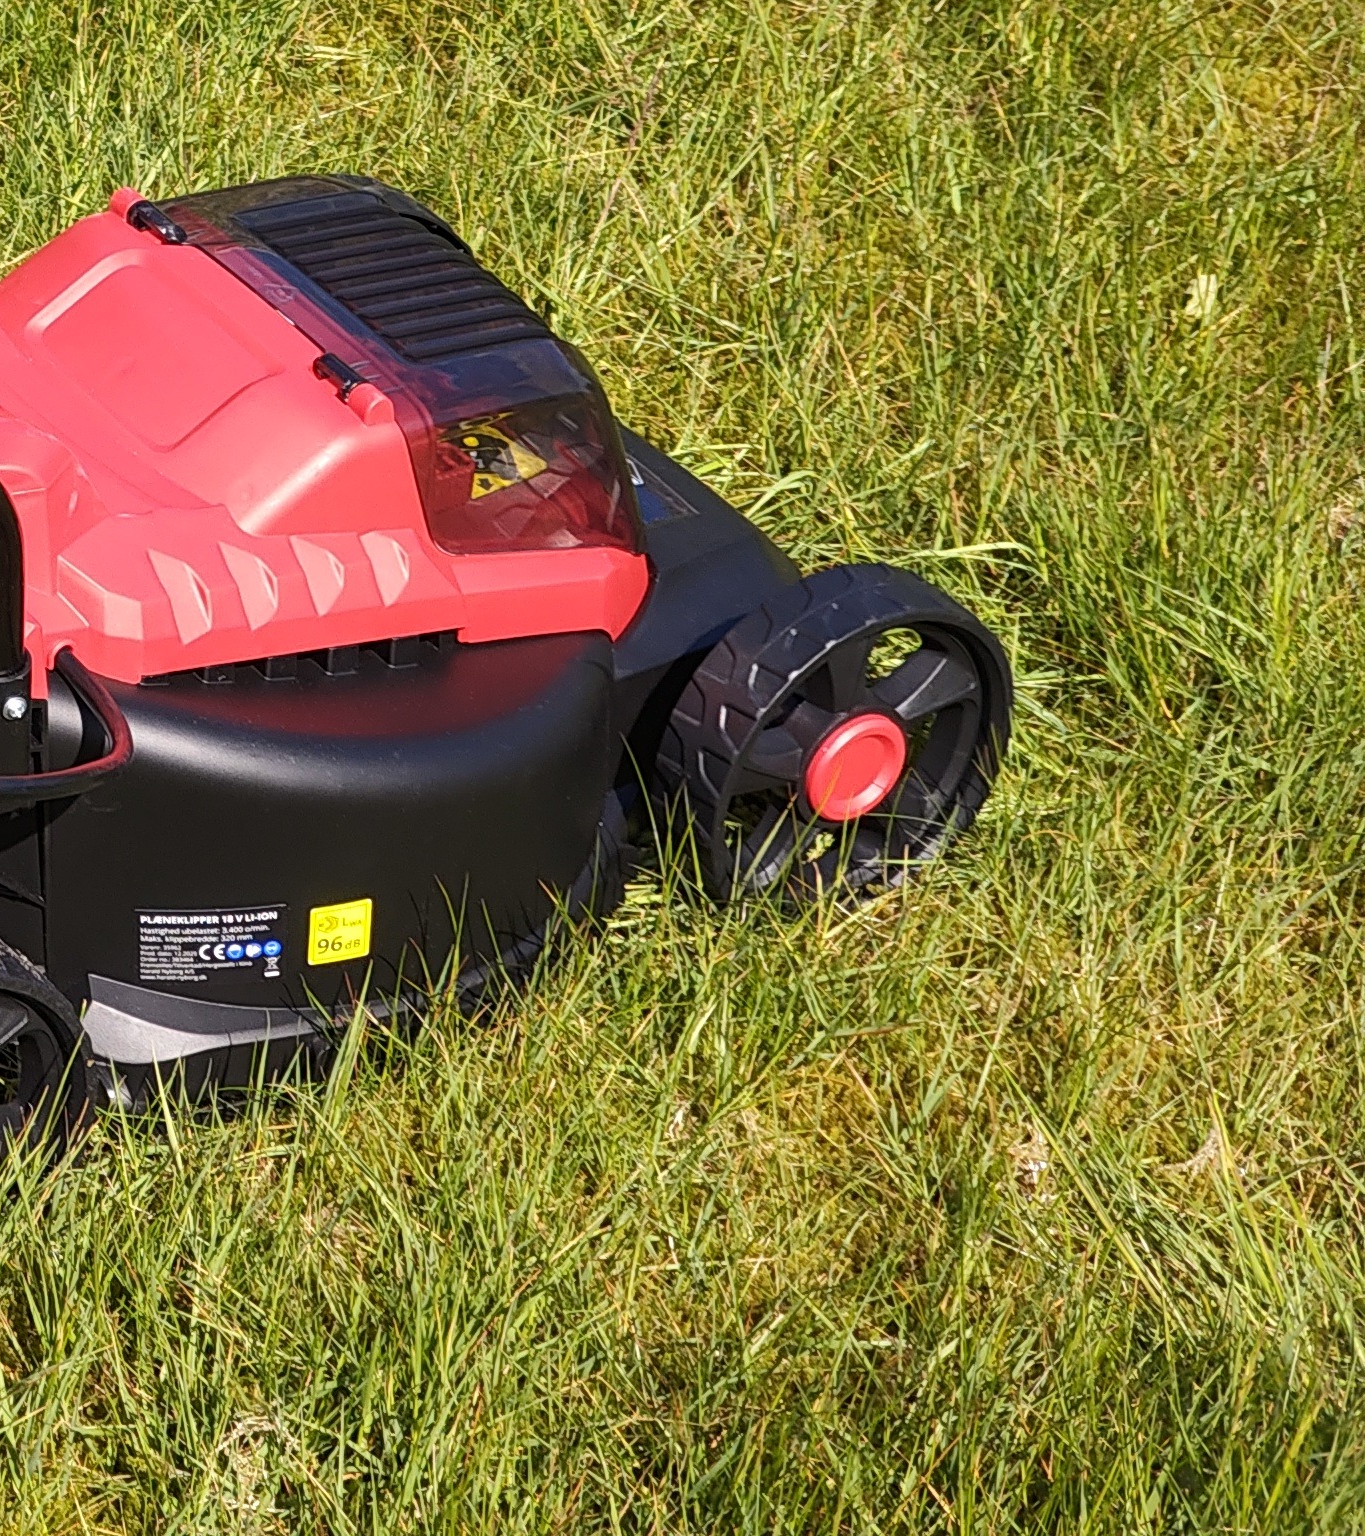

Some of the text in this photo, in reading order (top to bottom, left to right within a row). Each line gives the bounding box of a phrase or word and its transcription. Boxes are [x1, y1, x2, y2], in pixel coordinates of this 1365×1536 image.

[140, 911, 278, 925] PLÆNEKLIPPER 18 V LI-ION
[140, 927, 180, 935] Hastighed
[222, 926, 243, 934] 3.400
[140, 935, 163, 943] Maks.
[221, 934, 235, 943] 320
[317, 936, 361, 955] 96 dB
